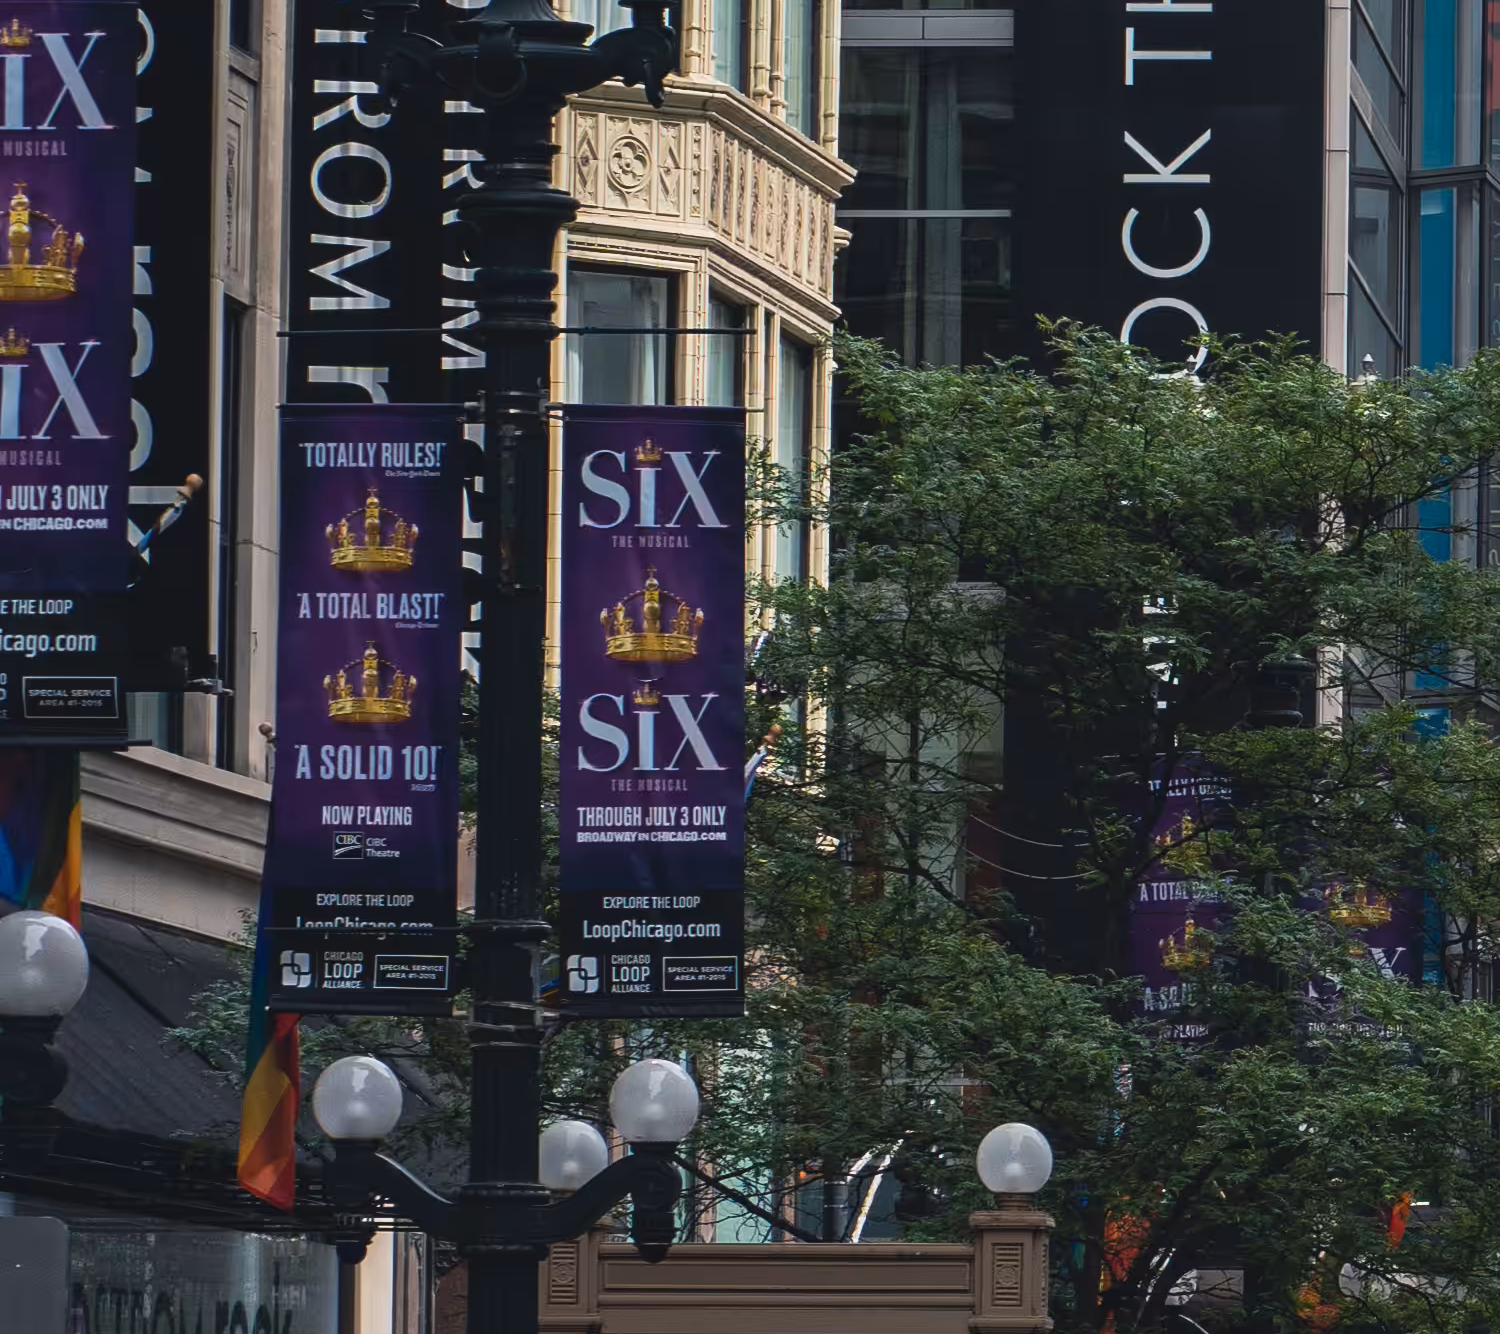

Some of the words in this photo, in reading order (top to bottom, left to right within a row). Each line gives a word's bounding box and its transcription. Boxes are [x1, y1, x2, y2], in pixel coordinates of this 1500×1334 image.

[0, 32, 118, 130] IX
[1120, 128, 1212, 377] OCK
[579, 449, 731, 529] SIX
[7, 485, 46, 511] JULY
[51, 486, 63, 510] 3
[67, 485, 108, 511] ONLY
[612, 535, 633, 548] THE
[639, 535, 690, 548] MUSICAL
[12, 599, 37, 614] THE
[39, 599, 73, 614] LOOP
[316, 593, 372, 619] TOTAL
[577, 693, 729, 772] SIX
[320, 744, 392, 781] SOLID
[322, 805, 352, 826] NOW
[357, 805, 413, 826] PLAYING
[577, 806, 642, 827] THROUGH
[645, 806, 677, 827] JULY
[680, 806, 690, 827] 3
[692, 806, 727, 827] ONLY
[336, 834, 363, 846] CIBC
[366, 837, 387, 847] CIBC
[366, 848, 401, 858] Theatre
[316, 893, 363, 907] EXPLORE
[365, 893, 385, 907] THE
[387, 894, 414, 907] LOOP
[603, 896, 650, 909] EXPLORE
[652, 896, 672, 909] THE
[673, 896, 700, 909] LOOP
[583, 919, 721, 943] LoopChicago.com
[324, 951, 364, 961] CHICAGO
[611, 955, 651, 965] CHICAGO
[324, 963, 364, 979] LOOP
[612, 966, 651, 982] LOOP
[611, 984, 651, 993] ALLIANCE
